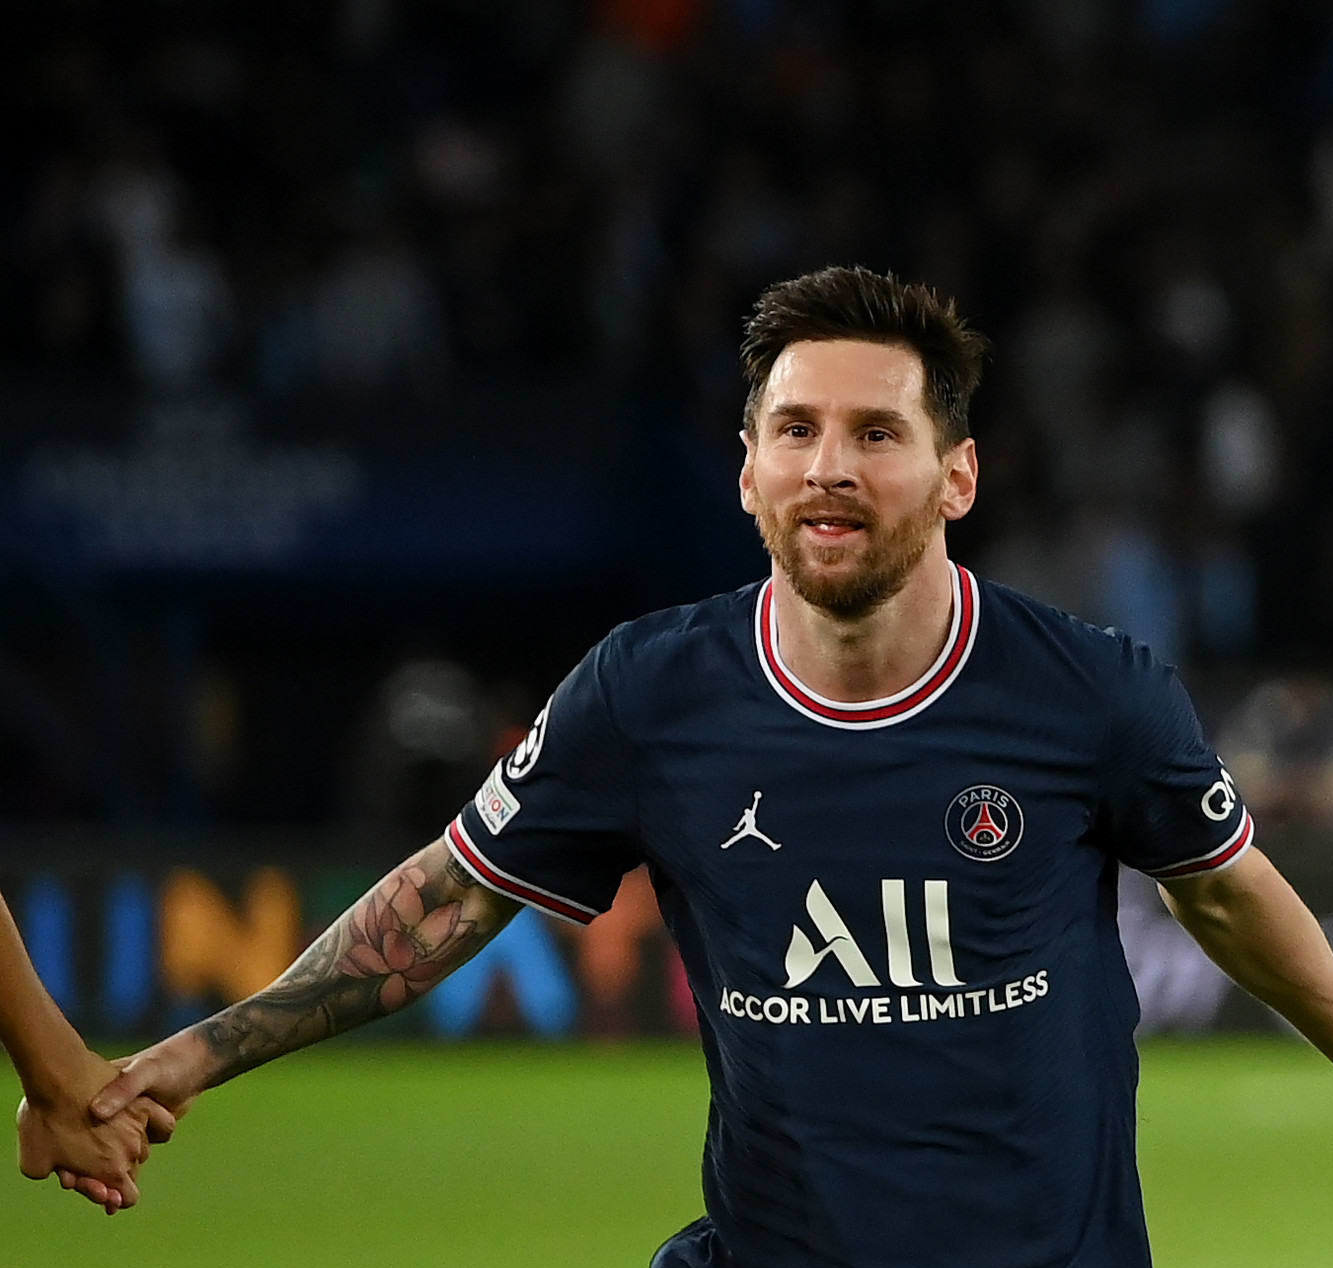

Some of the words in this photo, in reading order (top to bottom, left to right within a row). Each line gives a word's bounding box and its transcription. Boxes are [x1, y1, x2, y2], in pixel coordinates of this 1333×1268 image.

[959, 789, 1010, 808] PARIS
[1201, 754, 1236, 821] QN
[720, 987, 811, 1024] ACCOR
[820, 998, 891, 1024] LIVE
[902, 970, 1049, 1022] LIMITLESS
